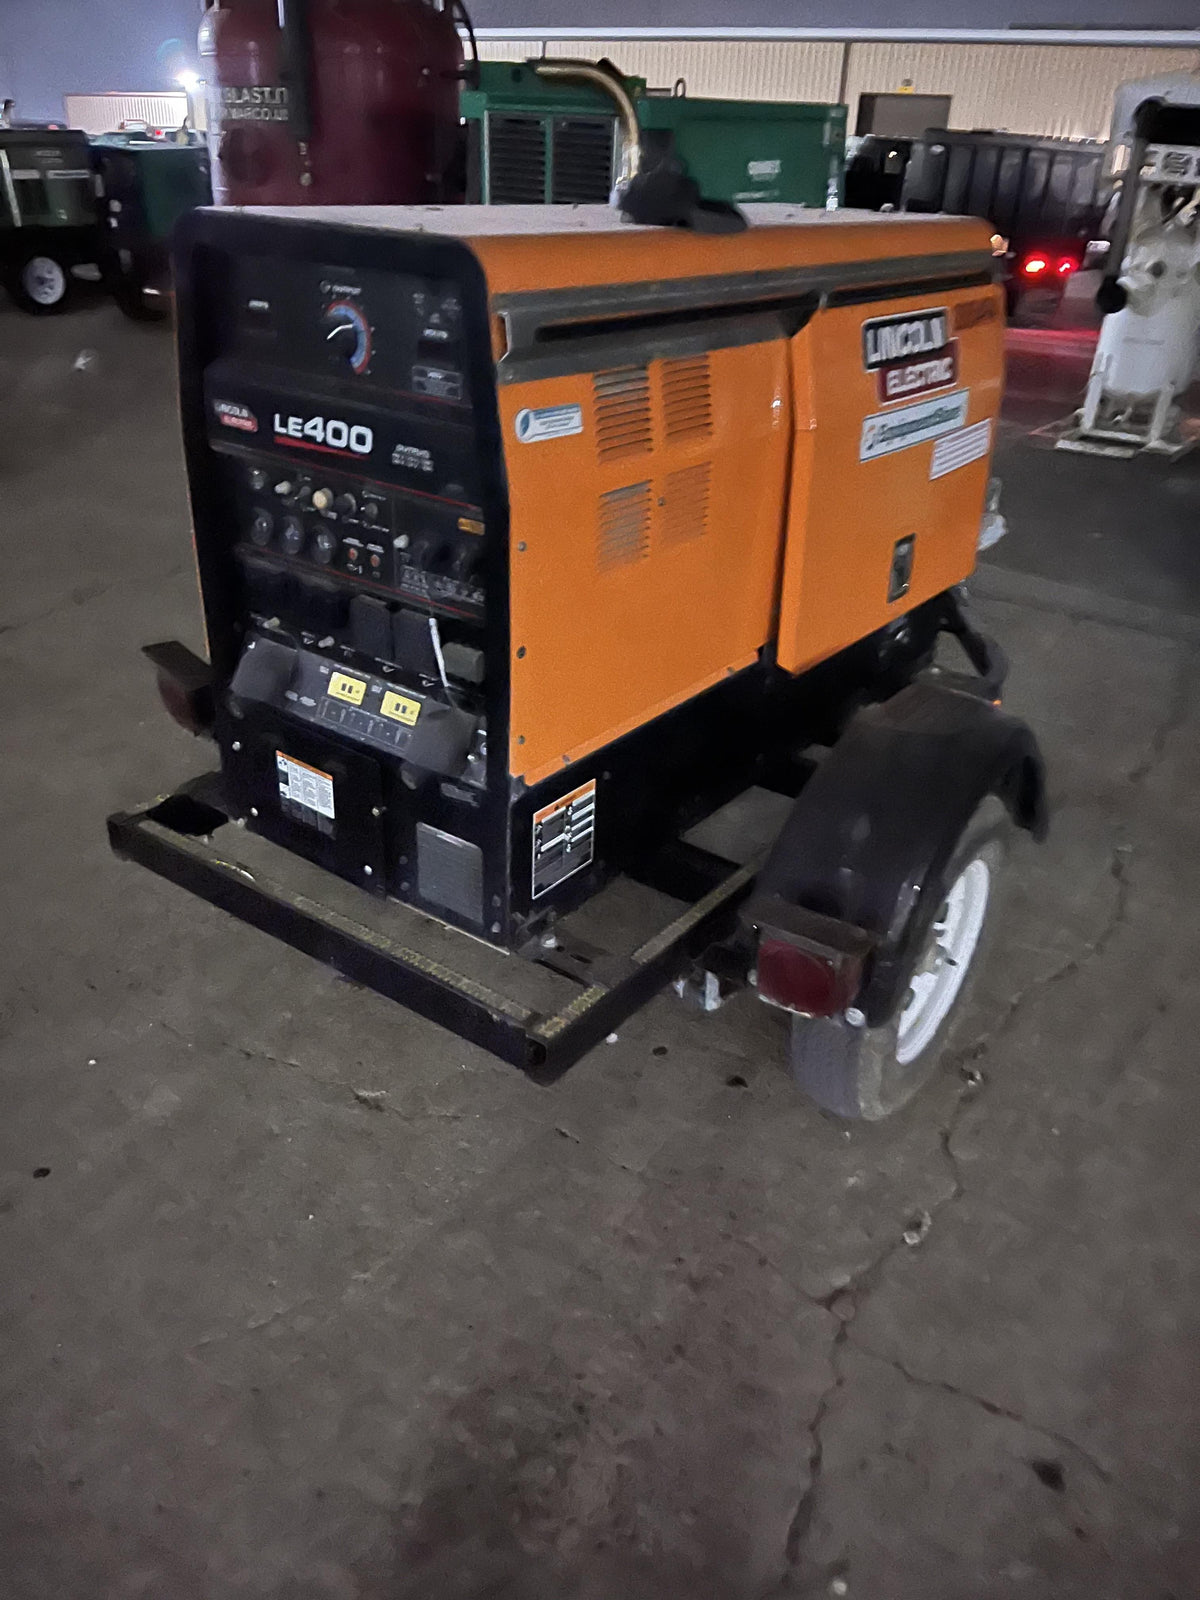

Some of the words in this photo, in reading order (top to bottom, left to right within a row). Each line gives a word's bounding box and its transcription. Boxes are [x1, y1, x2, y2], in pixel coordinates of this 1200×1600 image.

[866, 316, 947, 363] LINCOLN
[886, 357, 953, 396] ELECTRIC
[274, 413, 373, 454] LE400
